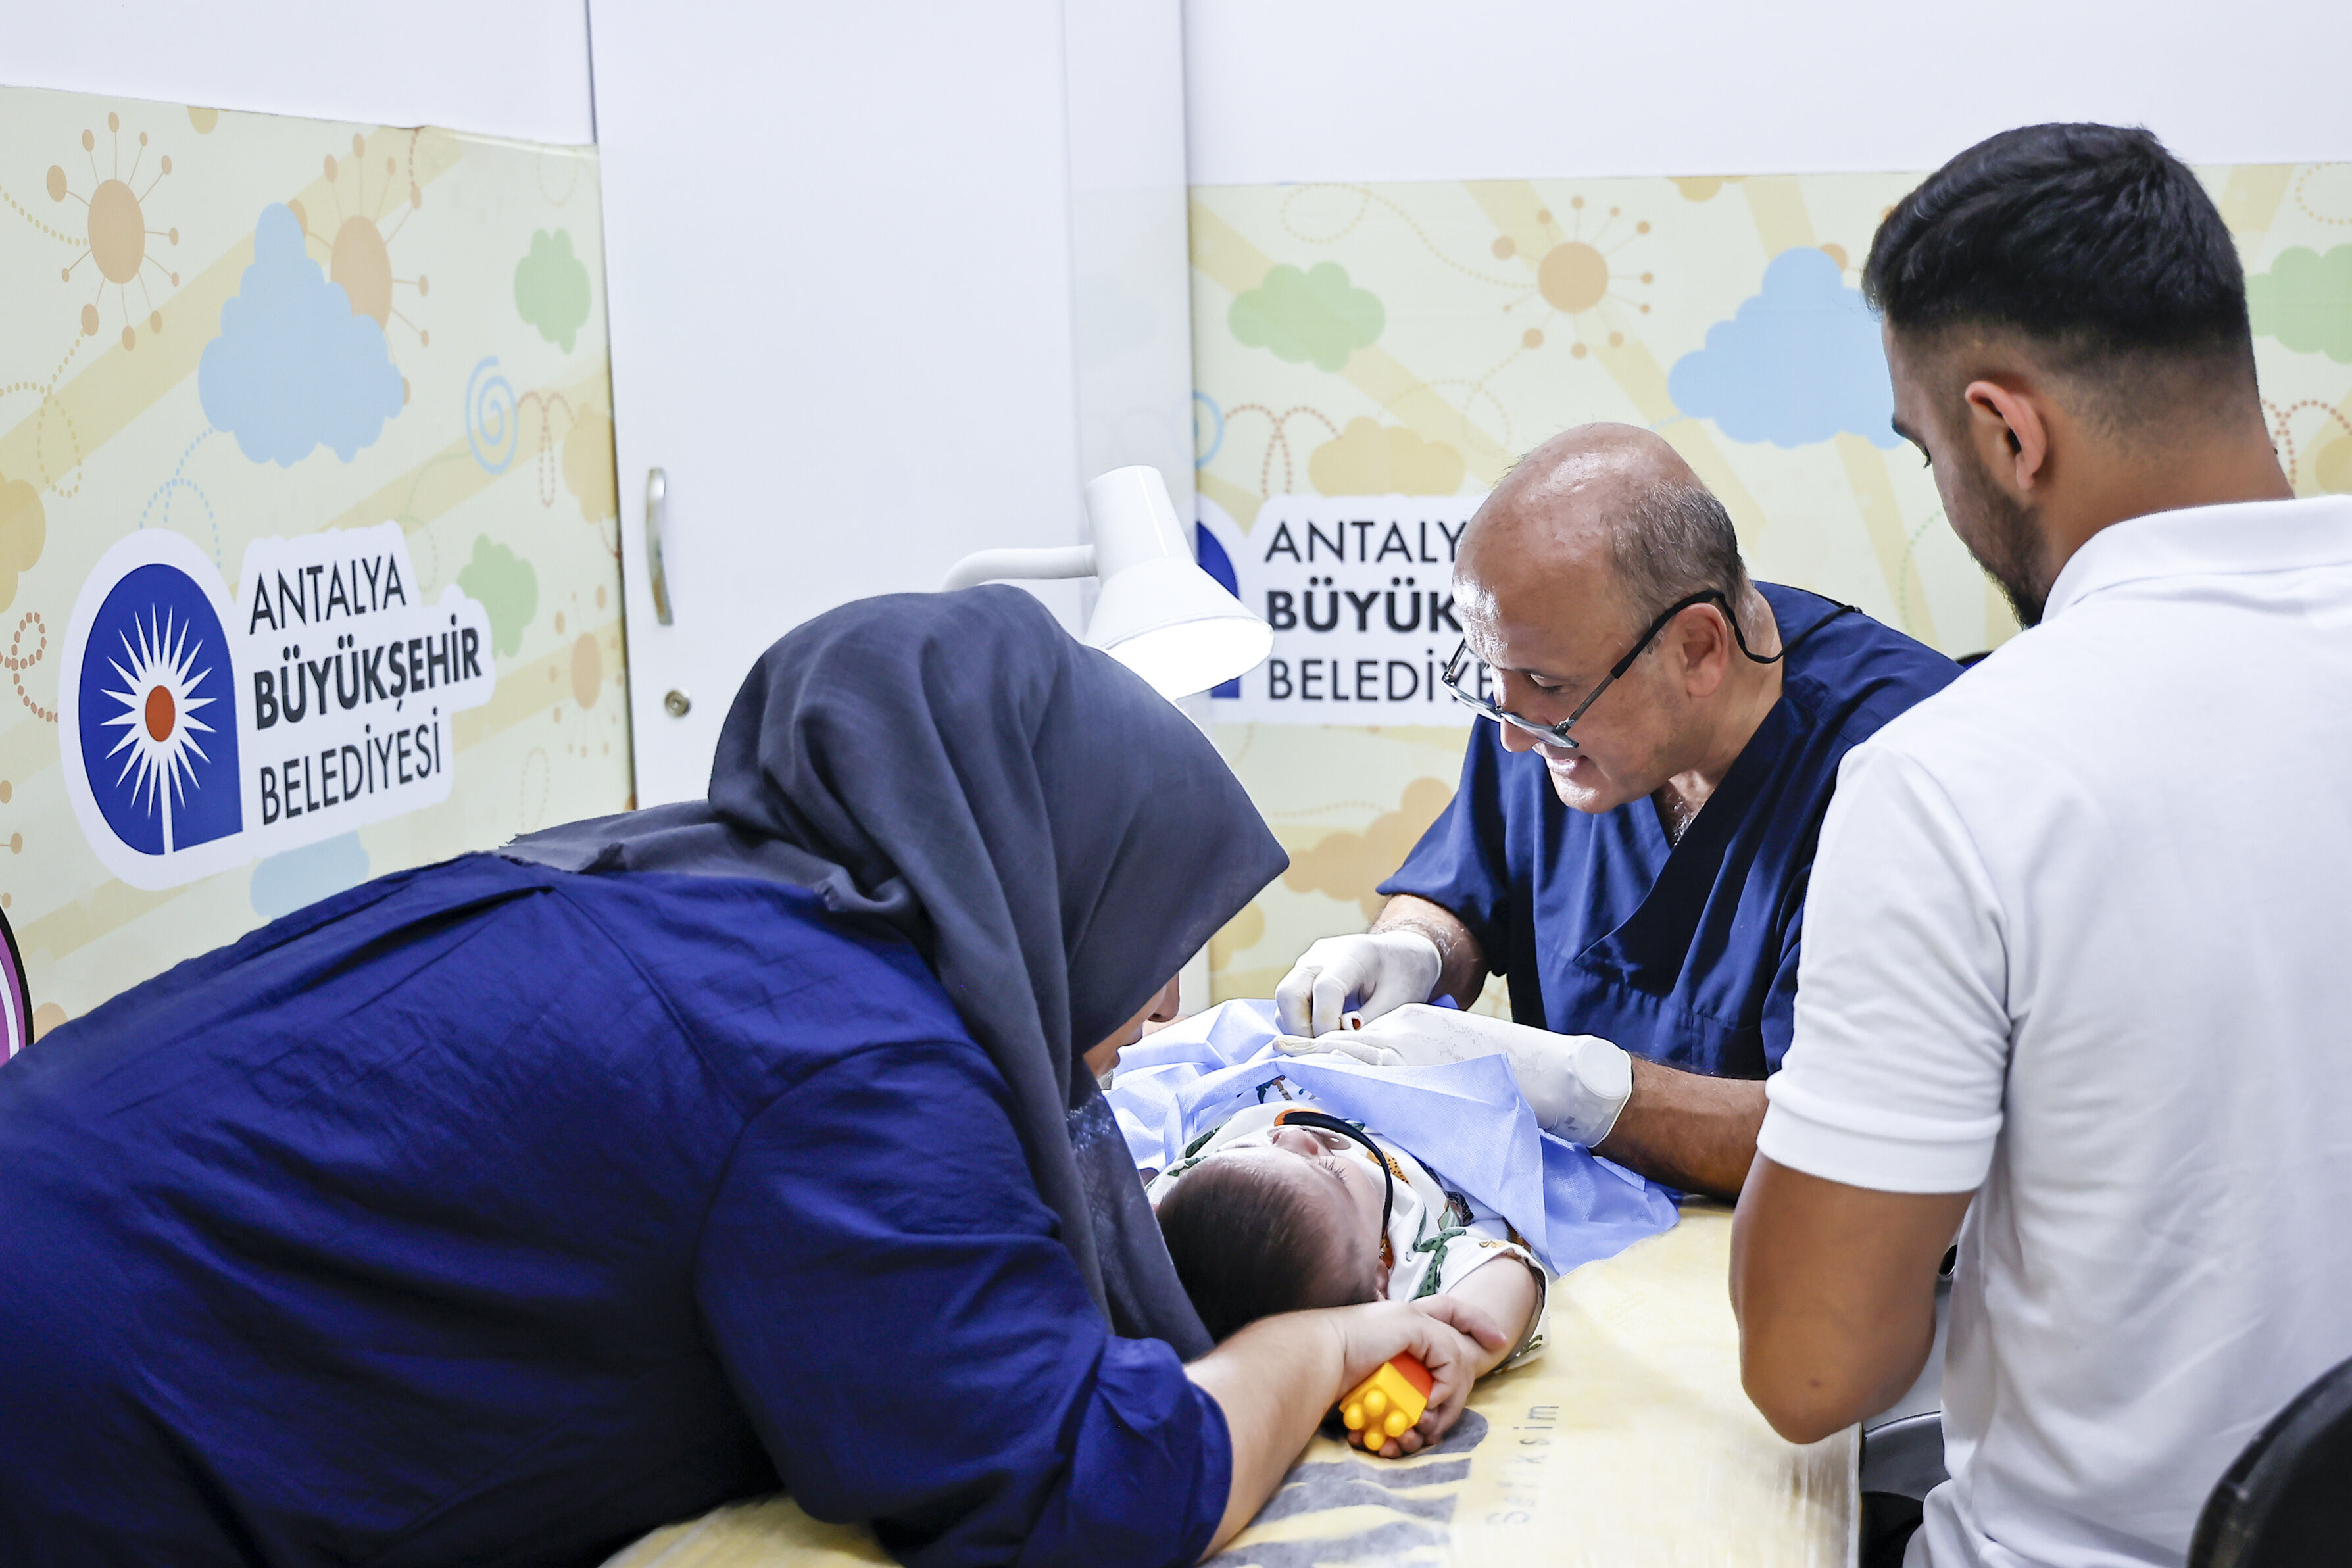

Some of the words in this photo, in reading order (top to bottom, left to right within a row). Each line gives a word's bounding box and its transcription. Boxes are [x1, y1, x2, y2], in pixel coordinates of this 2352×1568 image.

[1265, 521, 1467, 563] ANTALY
[249, 552, 406, 635] ANTALYA
[1266, 576, 1464, 632] BÜYÜK
[253, 613, 483, 731] BÜYÜKŞEHİR
[1269, 649, 1493, 703] BELEDİYE
[260, 706, 441, 826] BELEDİYESİ
